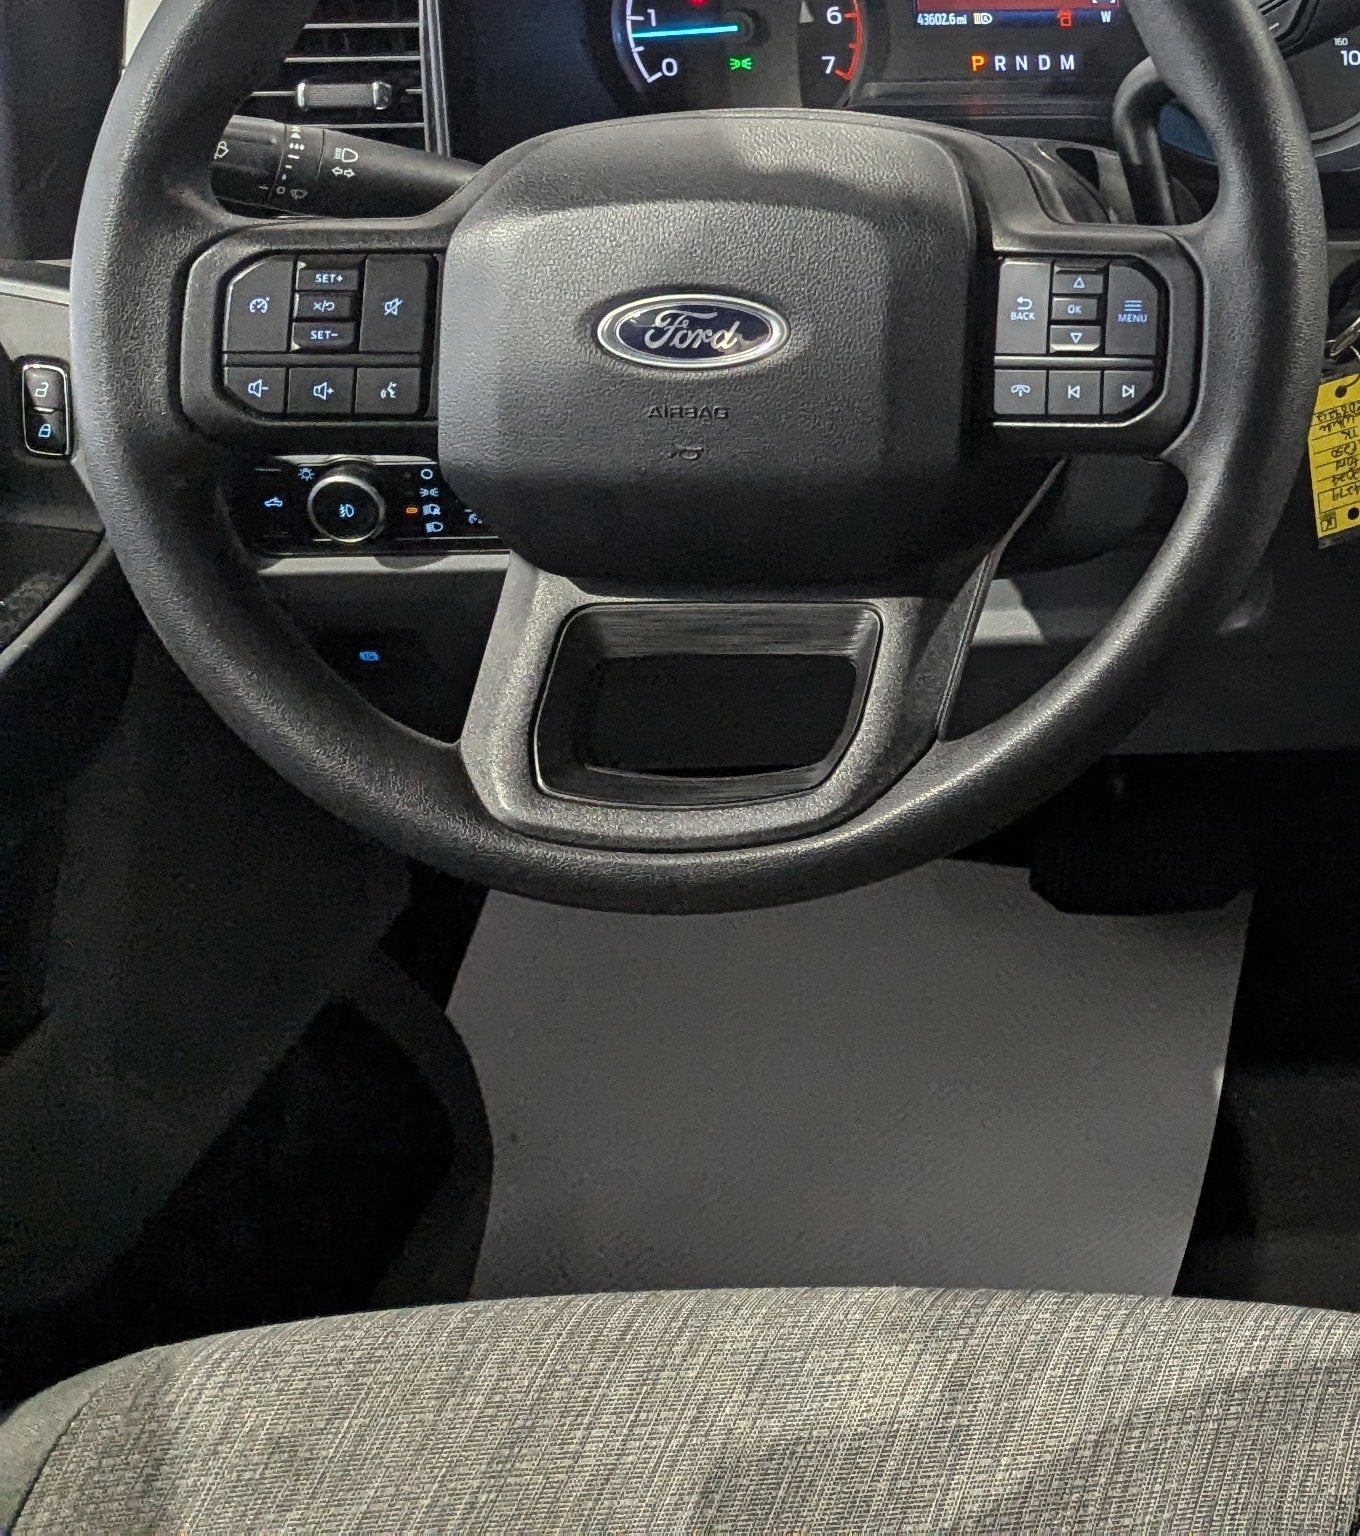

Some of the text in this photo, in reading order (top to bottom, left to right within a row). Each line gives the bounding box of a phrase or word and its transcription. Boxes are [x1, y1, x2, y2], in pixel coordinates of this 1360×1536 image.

[647, 8, 657, 27] 1
[826, 7, 842, 24] 6
[1100, 11, 1112, 23] W
[662, 57, 678, 77] 0
[821, 55, 836, 74] 7
[971, 54, 1075, 72] P R N D M
[1010, 311, 1036, 321] BACK
[1067, 304, 1082, 314] OK
[1118, 313, 1148, 323] MENU
[643, 309, 741, 350] Ford
[648, 405, 730, 419] AIRBAG
